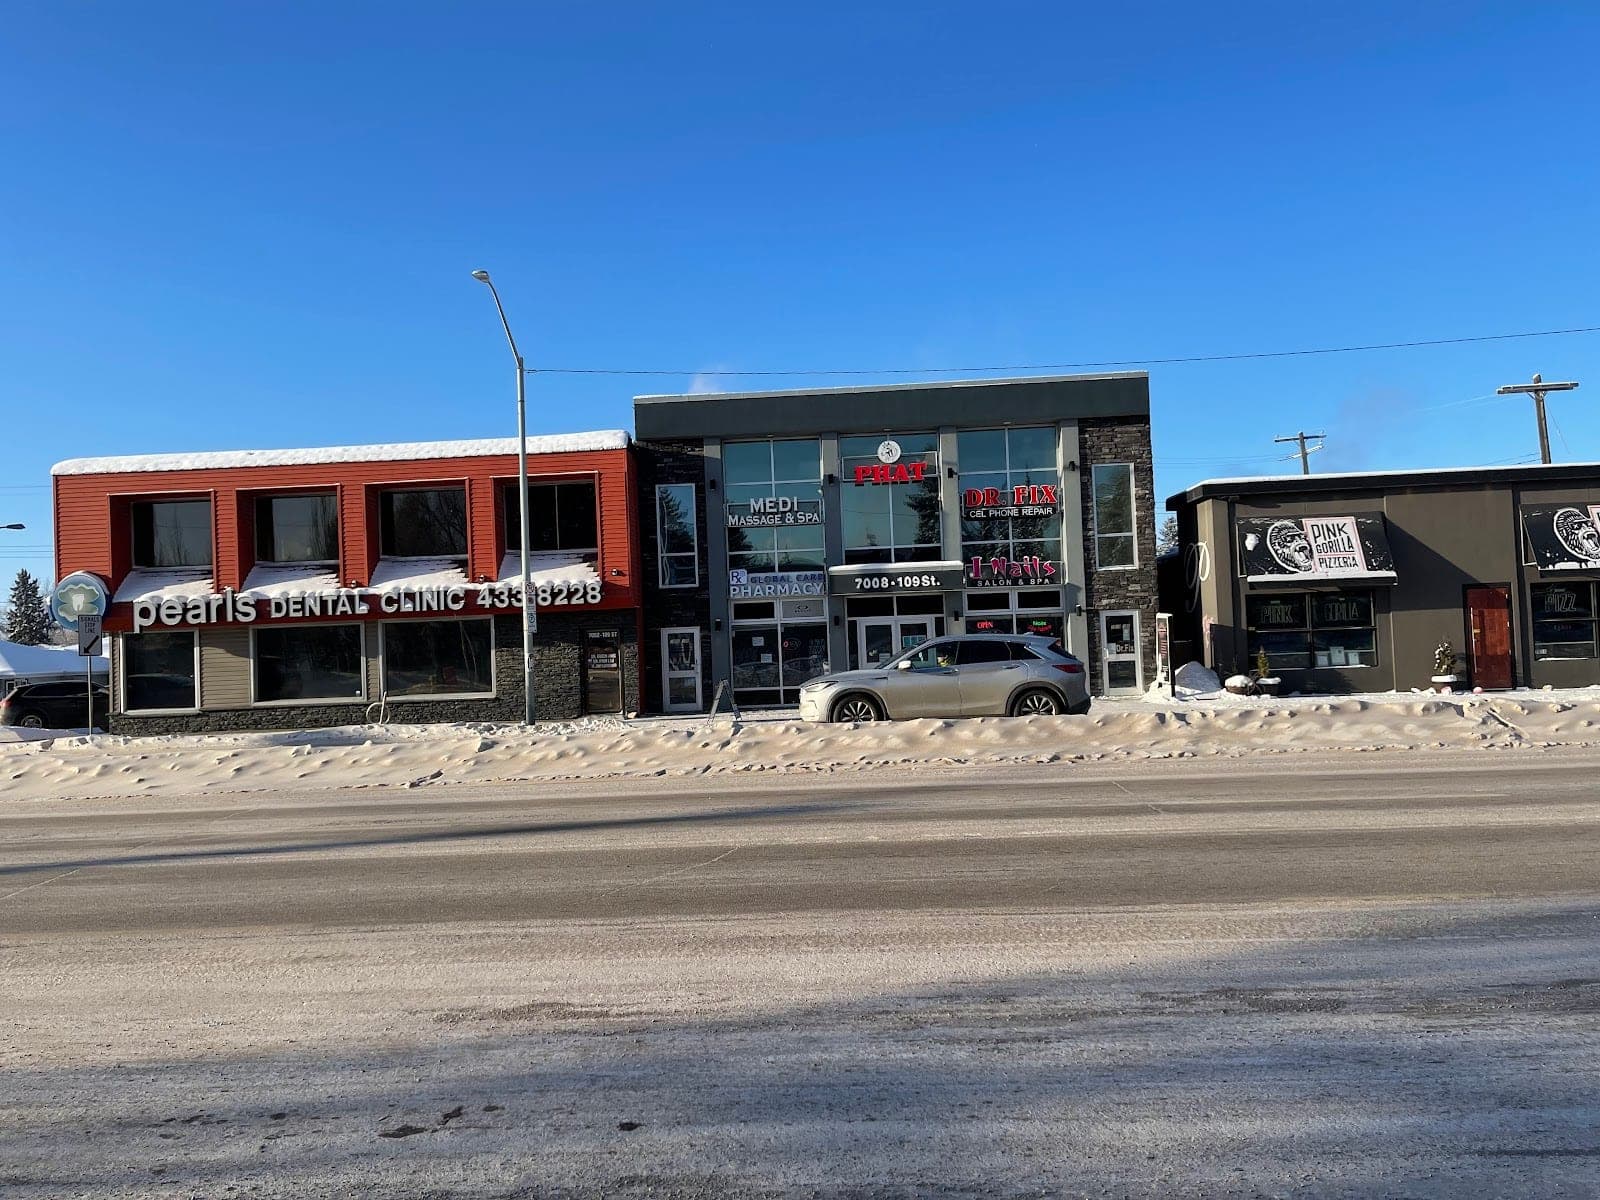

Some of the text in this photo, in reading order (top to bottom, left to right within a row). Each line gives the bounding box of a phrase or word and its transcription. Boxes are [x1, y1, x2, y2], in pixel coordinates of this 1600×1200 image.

[855, 462, 927, 484] PHAT
[966, 484, 1058, 507] DR. FIX
[750, 496, 799, 513] MEDI
[969, 507, 1054, 518] CEL PHONE REPAIR
[728, 511, 820, 527] MASSAGE & SPA
[1311, 523, 1349, 544] PINK
[1315, 535, 1355, 554] GORILLA
[1318, 556, 1359, 569] PIZZERIA
[750, 573, 825, 584] GLOBAL CARE
[730, 583, 824, 597] PHARMACY
[133, 588, 256, 633] pearls
[270, 591, 370, 618] DENTAL
[381, 588, 465, 613] CLINIC
[977, 621, 994, 629] OPEN
